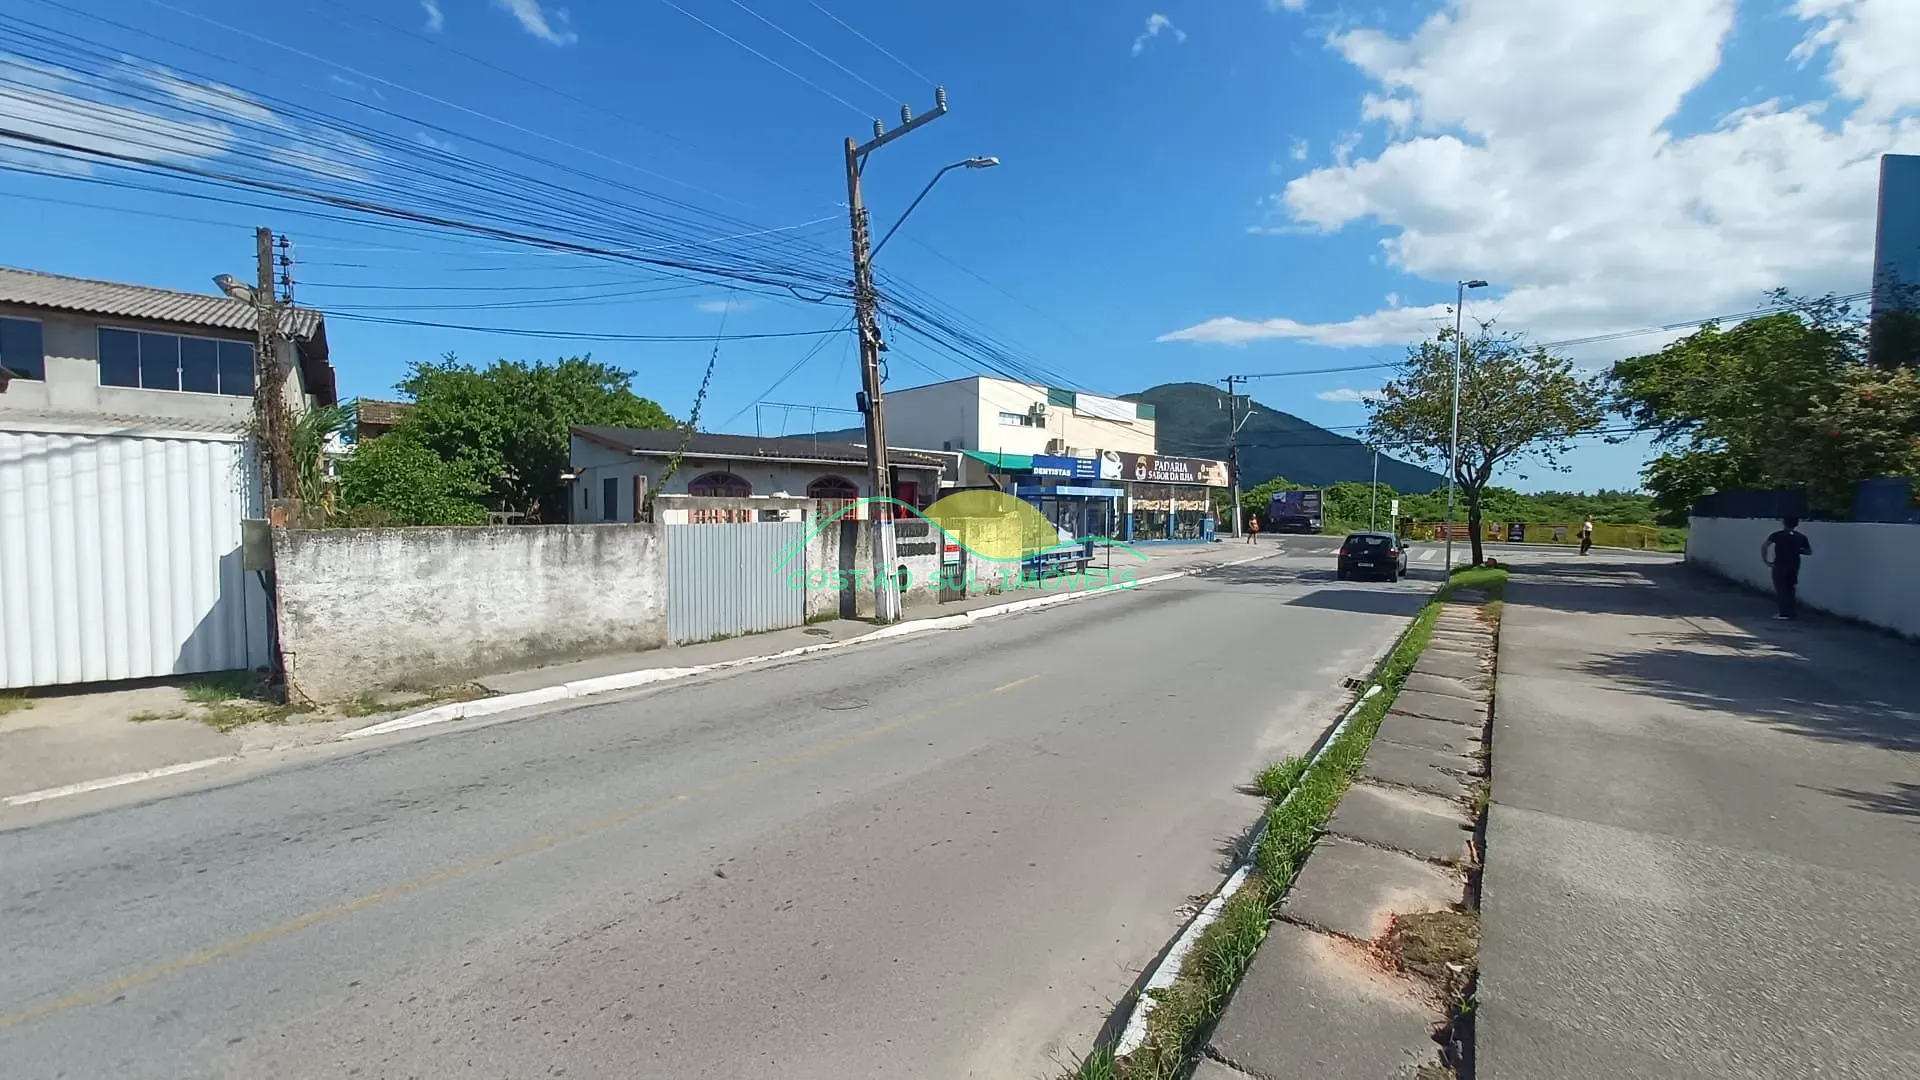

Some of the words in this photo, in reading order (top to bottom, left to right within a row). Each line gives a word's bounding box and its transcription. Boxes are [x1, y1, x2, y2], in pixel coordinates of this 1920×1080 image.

[1033, 467, 1071, 477] DENTISTAS
[1154, 460, 1188, 473] PADARIA
[1148, 470, 1169, 480] SABOR
[1170, 472, 1179, 481] DA
